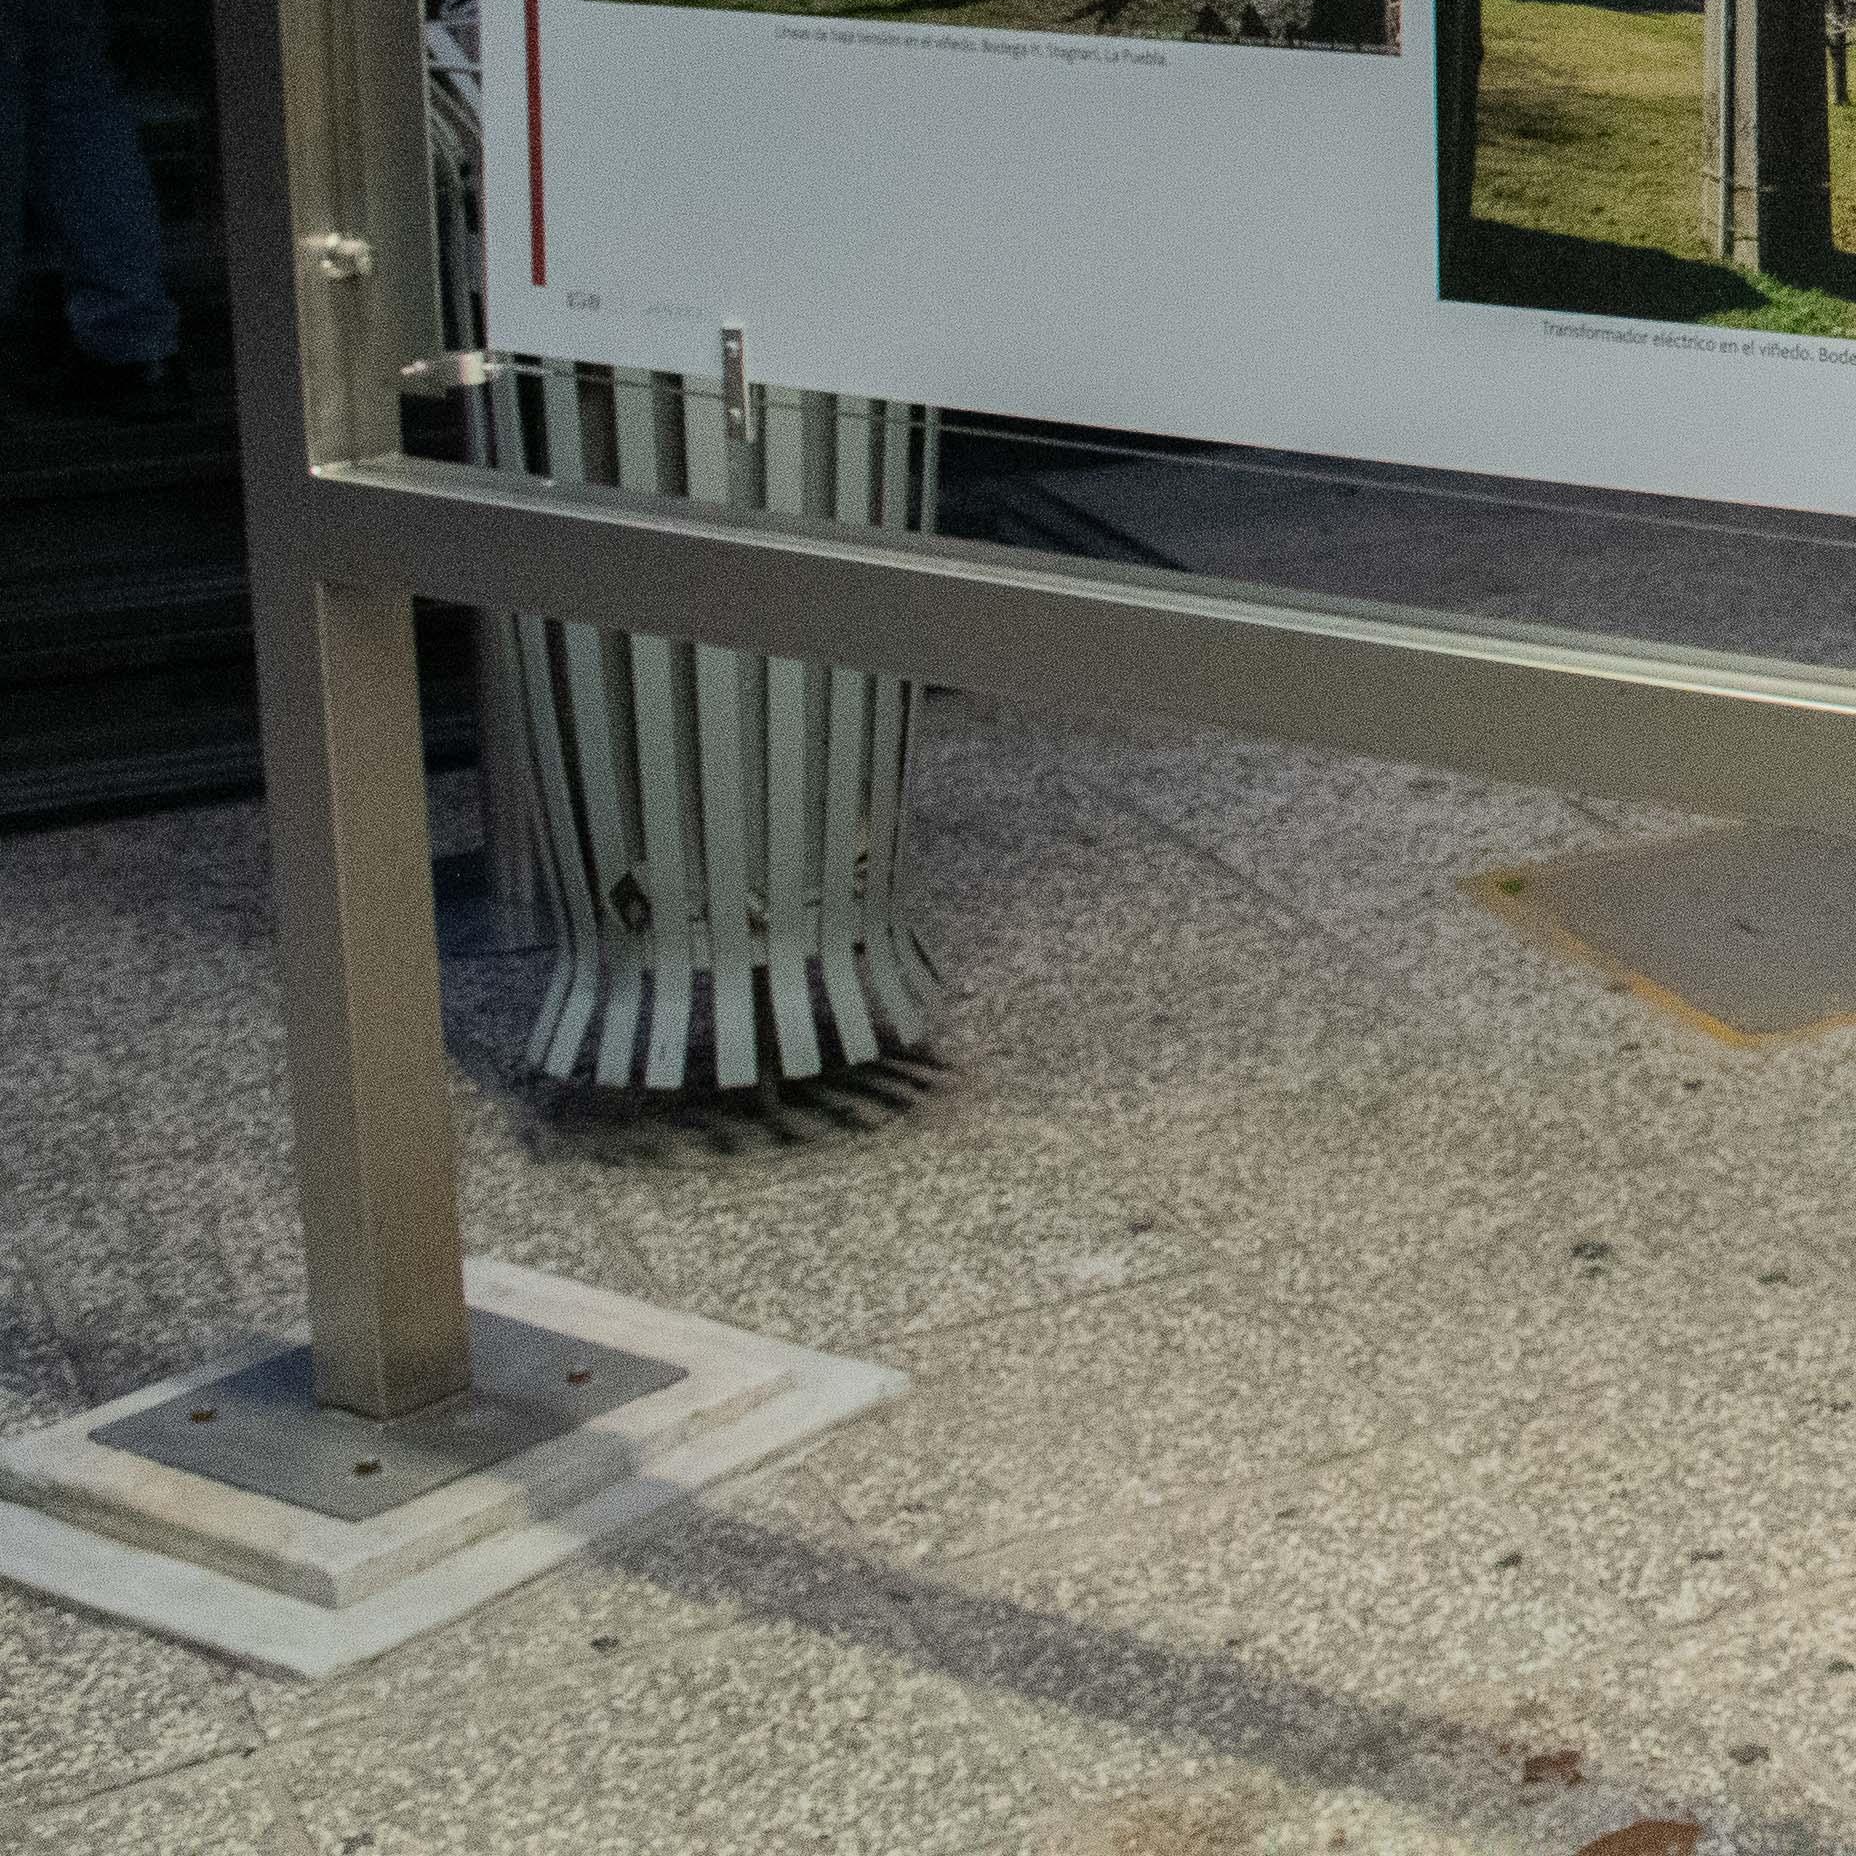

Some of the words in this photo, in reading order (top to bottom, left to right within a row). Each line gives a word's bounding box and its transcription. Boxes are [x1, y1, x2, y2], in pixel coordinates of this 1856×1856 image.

[1542, 319, 1648, 346] Transformador
[1653, 330, 1716, 354] eléctrico
[1720, 340, 1739, 355] en
[1742, 338, 1755, 356] el
[1759, 340, 1815, 363] viñedo.
